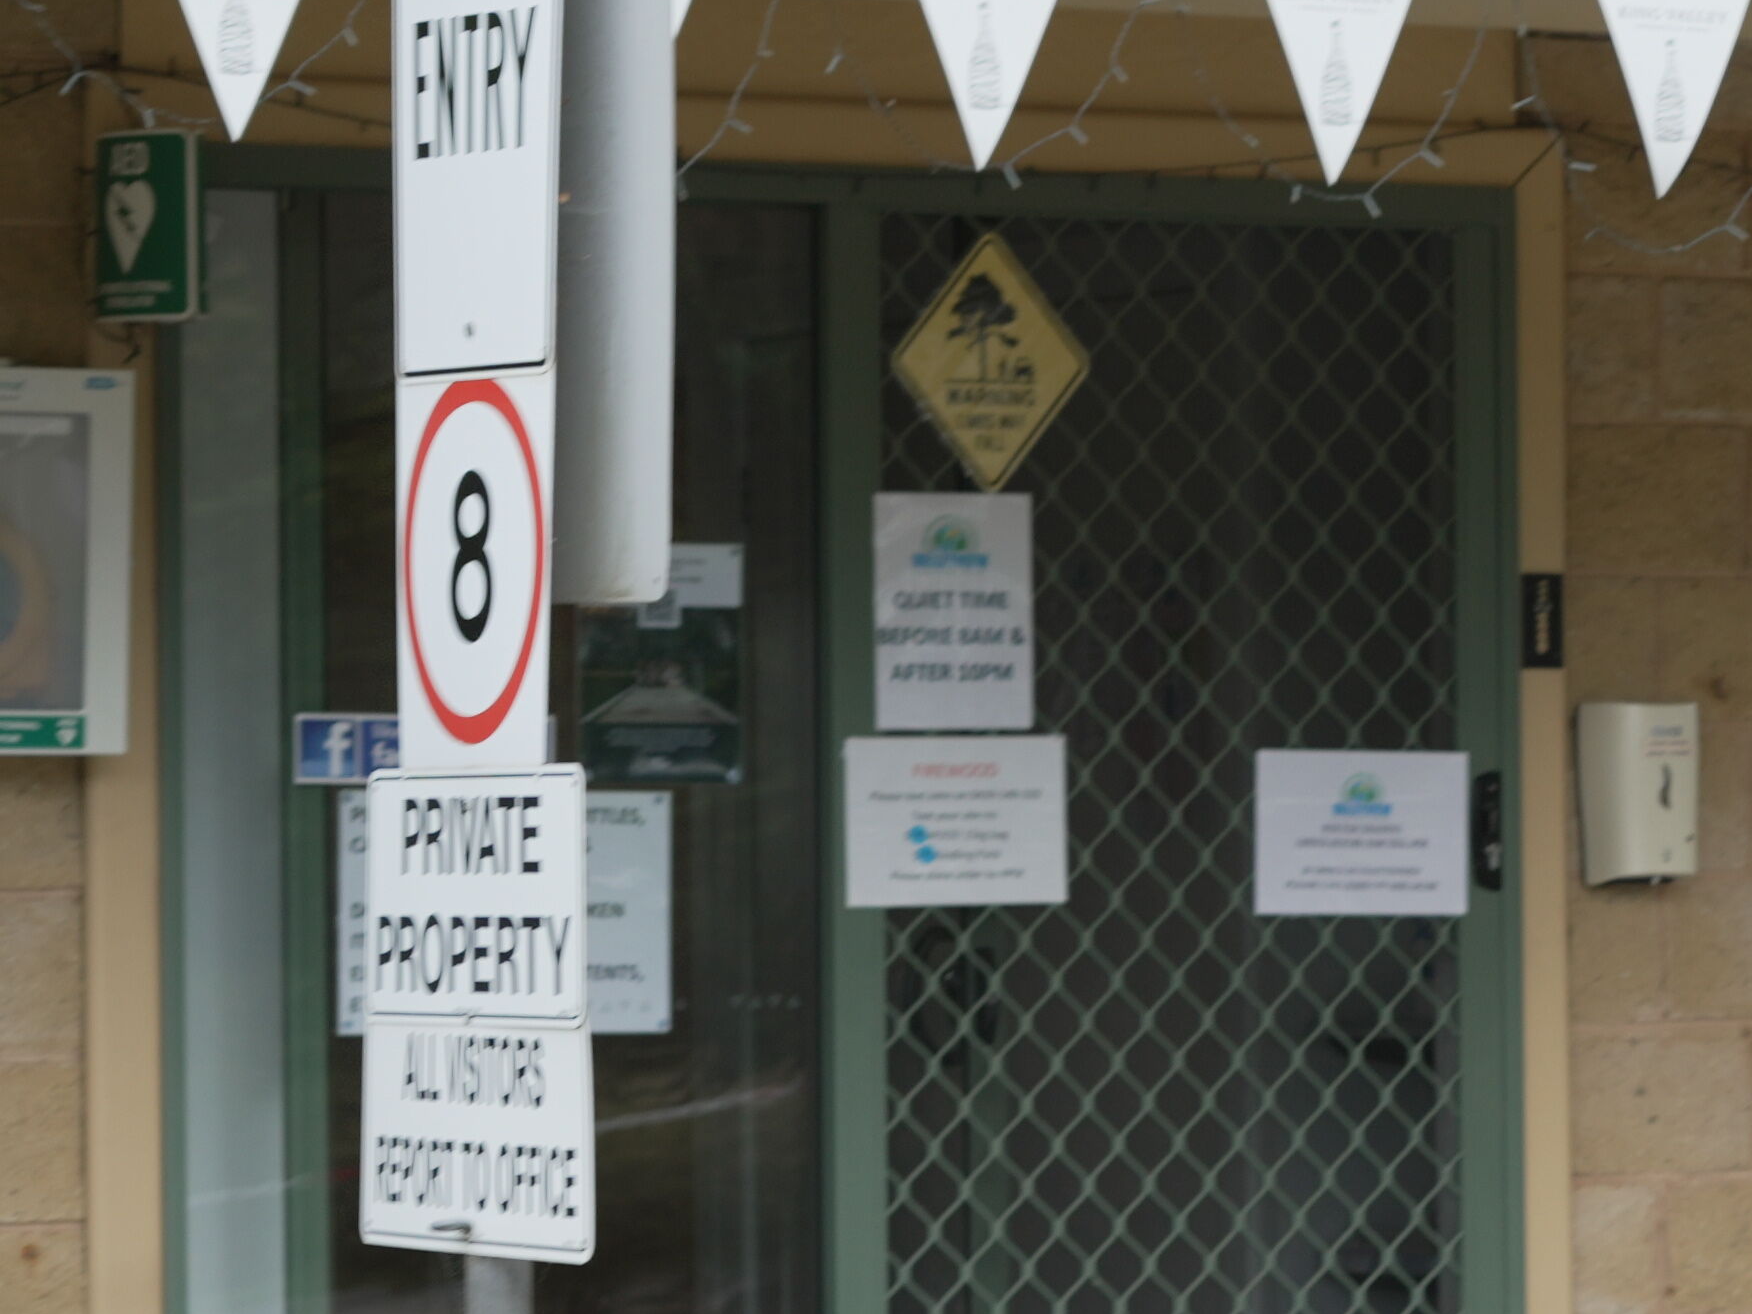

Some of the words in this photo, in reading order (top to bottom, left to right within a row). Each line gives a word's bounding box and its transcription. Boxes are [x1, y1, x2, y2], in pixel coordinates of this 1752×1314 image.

[411, 4, 540, 161] ENTRY
[452, 469, 494, 643] 8
[401, 795, 541, 876] PRIVATE
[374, 913, 572, 996] PROPERTY
[401, 1033, 440, 1103] ALL
[446, 1035, 546, 1109] VISITORS
[373, 1135, 454, 1211] REPORT
[461, 1140, 489, 1212] TO
[494, 1145, 578, 1219] OFFICE
